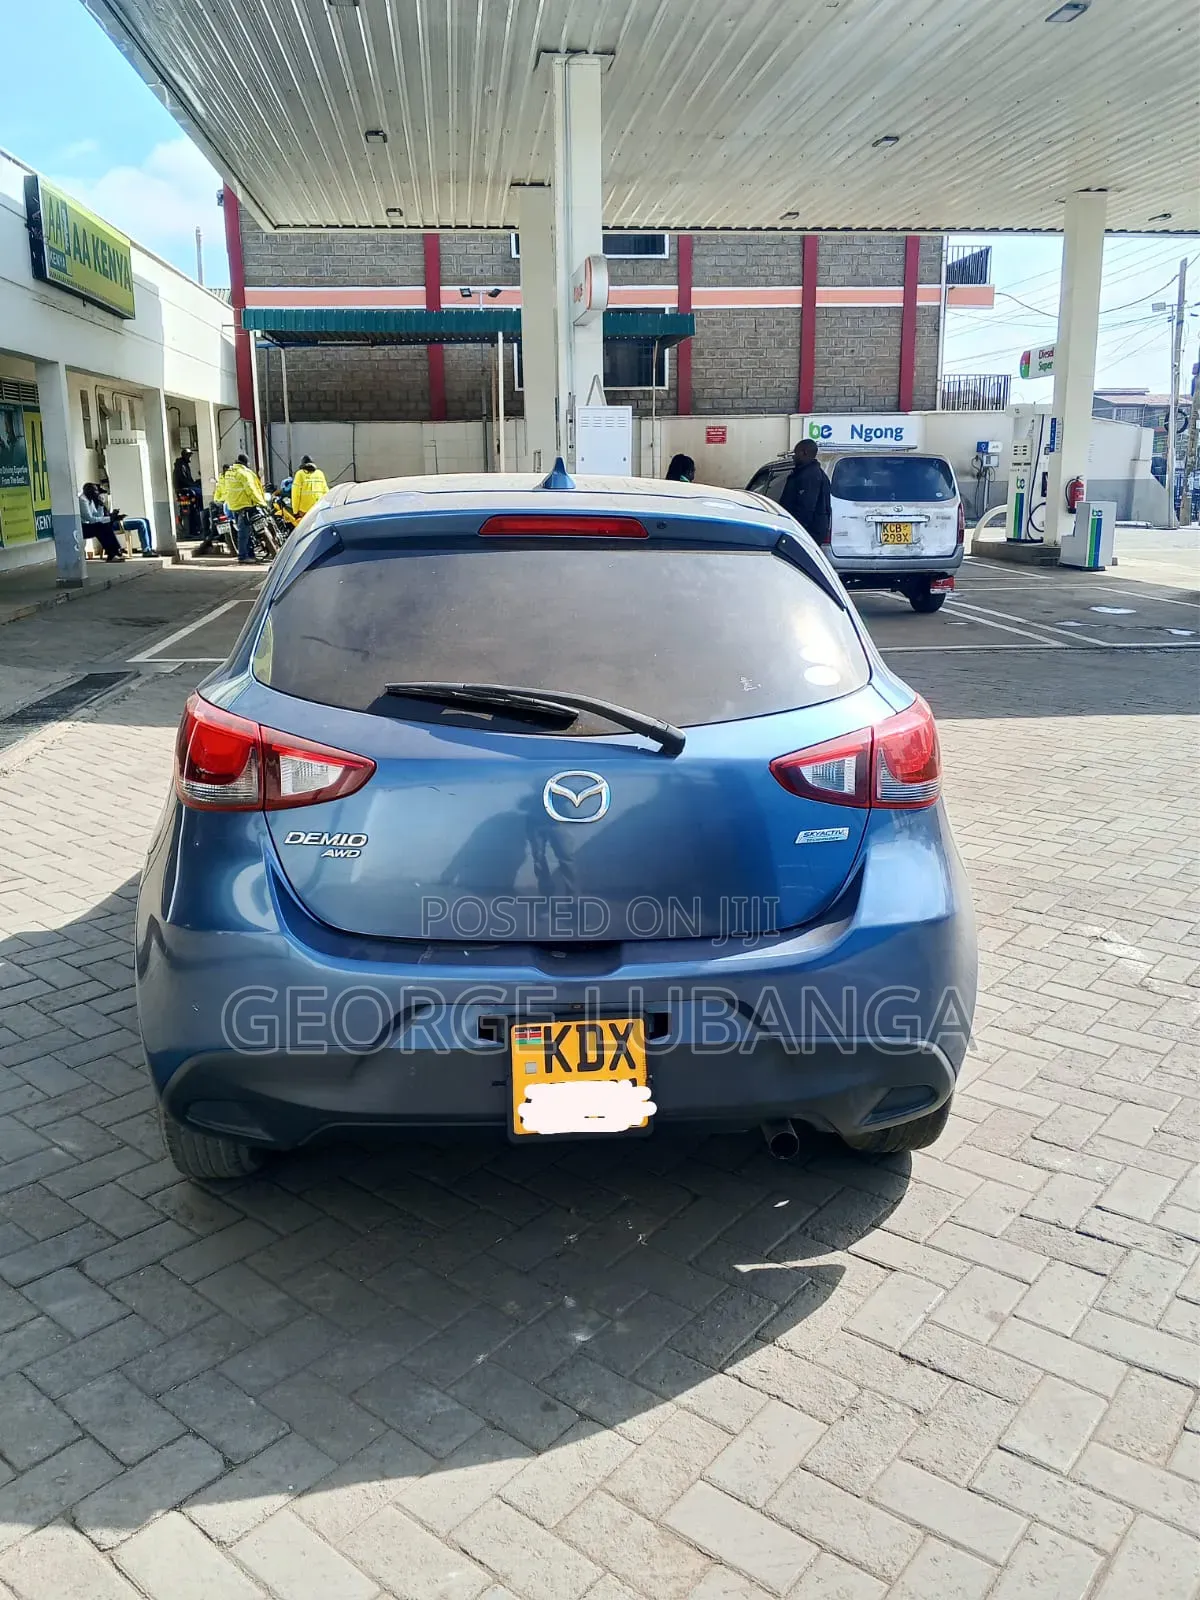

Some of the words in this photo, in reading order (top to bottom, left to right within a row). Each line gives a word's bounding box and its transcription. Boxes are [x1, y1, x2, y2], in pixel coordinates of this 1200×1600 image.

[48, 196, 63, 248] AA
[73, 222, 91, 269] AA
[92, 233, 133, 292] KENYA
[1038, 347, 1055, 360] Diesel
[1038, 361, 1054, 372] Super
[808, 421, 833, 440] be
[850, 424, 905, 443] Ngong
[35, 514, 52, 531] KENY
[882, 523, 902, 533] KCB
[883, 533, 909, 543] 298X
[284, 831, 369, 848] DEMIO
[803, 830, 843, 838] SKYACTIV
[320, 849, 361, 859] AWD
[543, 1022, 637, 1074] KDX
